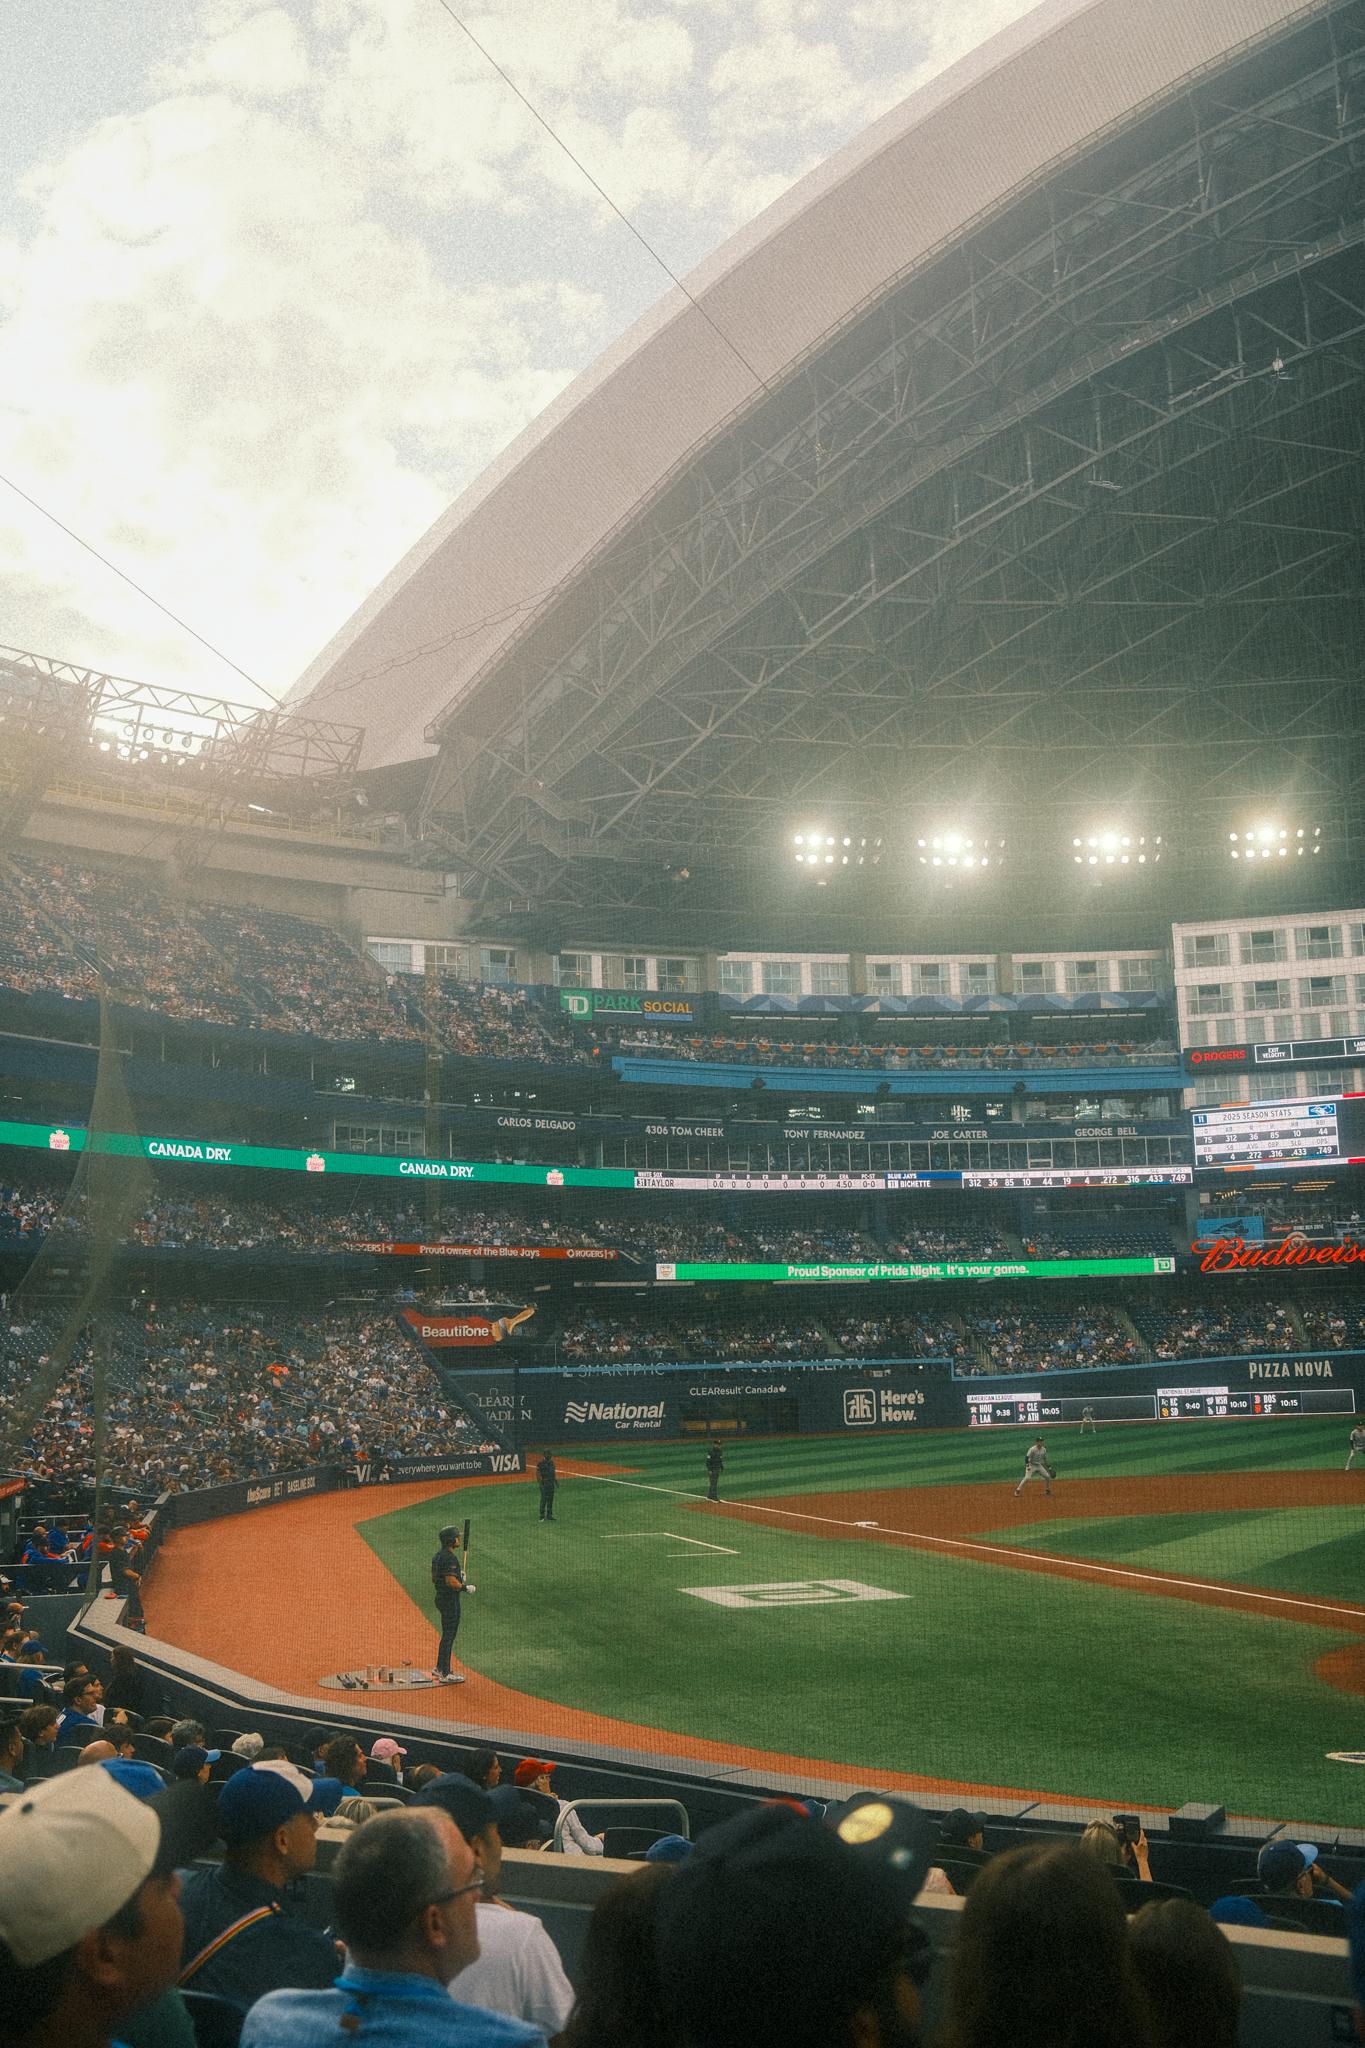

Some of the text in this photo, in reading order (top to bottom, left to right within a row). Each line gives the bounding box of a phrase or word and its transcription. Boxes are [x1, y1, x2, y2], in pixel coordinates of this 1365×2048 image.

[563, 995, 640, 1014] TD PARK
[643, 1001, 693, 1013] SOCIAL
[1204, 1050, 1245, 1061] ROGERS
[1262, 1051, 1286, 1059] VELOCITY
[1223, 1109, 1292, 1121] 2025 SEASON STATS
[497, 1117, 576, 1130] CARLOS DELGADO
[645, 1125, 724, 1137] 4306 TOM CHEEK
[784, 1130, 865, 1140] TONY FERNANDEZ
[931, 1130, 988, 1139] JOE CARTER
[1075, 1127, 1138, 1137] GEORGE BELL
[1203, 1136, 1213, 1144] 75
[1225, 1134, 1238, 1142] 312
[1249, 1133, 1259, 1141] 36
[1270, 1131, 1280, 1139] 85
[149, 1142, 203, 1159] CANADA
[1246, 1151, 1262, 1159] .272
[1268, 1150, 1283, 1158] .316
[1291, 1149, 1307, 1157] .433
[1316, 1146, 1332, 1154] .749
[399, 1162, 447, 1176] CANADA
[647, 1179, 675, 1187] TAYLOR
[713, 1180, 724, 1188] 0.0
[900, 1180, 931, 1188] BICHETTE
[968, 1179, 982, 1187] 312
[988, 1179, 998, 1187] 36
[1004, 1178, 1014, 1186] 85
[1023, 1178, 1031, 1186] 10
[1042, 1177, 1053, 1185] 44
[1063, 1177, 1071, 1185] 19
[1100, 1176, 1117, 1184] .272
[1169, 1174, 1186, 1182] .749
[419, 1245, 540, 1259] Proud owner of the Blue Jays
[575, 1250, 604, 1258] ROGERS
[787, 1265, 1029, 1279] Proud Sponsor of Pride Night. It's your game.
[422, 1325, 489, 1337] BeautiTone
[1249, 1360, 1333, 1379] PIZZA NOVA
[690, 1385, 779, 1396] CLEAResult Canada
[880, 1390, 925, 1405] Here's
[1170, 1397, 1178, 1407] KC
[1263, 1394, 1276, 1403] BOS
[979, 1403, 992, 1412] HOU
[1027, 1402, 1038, 1412] CLE
[1185, 1402, 1201, 1410] 9:40
[1280, 1399, 1298, 1407] 10:15
[589, 1401, 664, 1420] National
[996, 1409, 1011, 1417] 9:38
[1042, 1407, 1060, 1415] 10:05
[1170, 1408, 1179, 1416] SD
[1216, 1406, 1227, 1414] LAD
[1264, 1404, 1272, 1413] SF
[881, 1406, 917, 1422] How.
[980, 1414, 991, 1423] LAA
[1027, 1412, 1039, 1422] ATH
[615, 1420, 661, 1429] Car Rental
[435, 1464, 449, 1473] you
[450, 1462, 466, 1470] want
[473, 1460, 482, 1468] be
[489, 1454, 521, 1472] VISA
